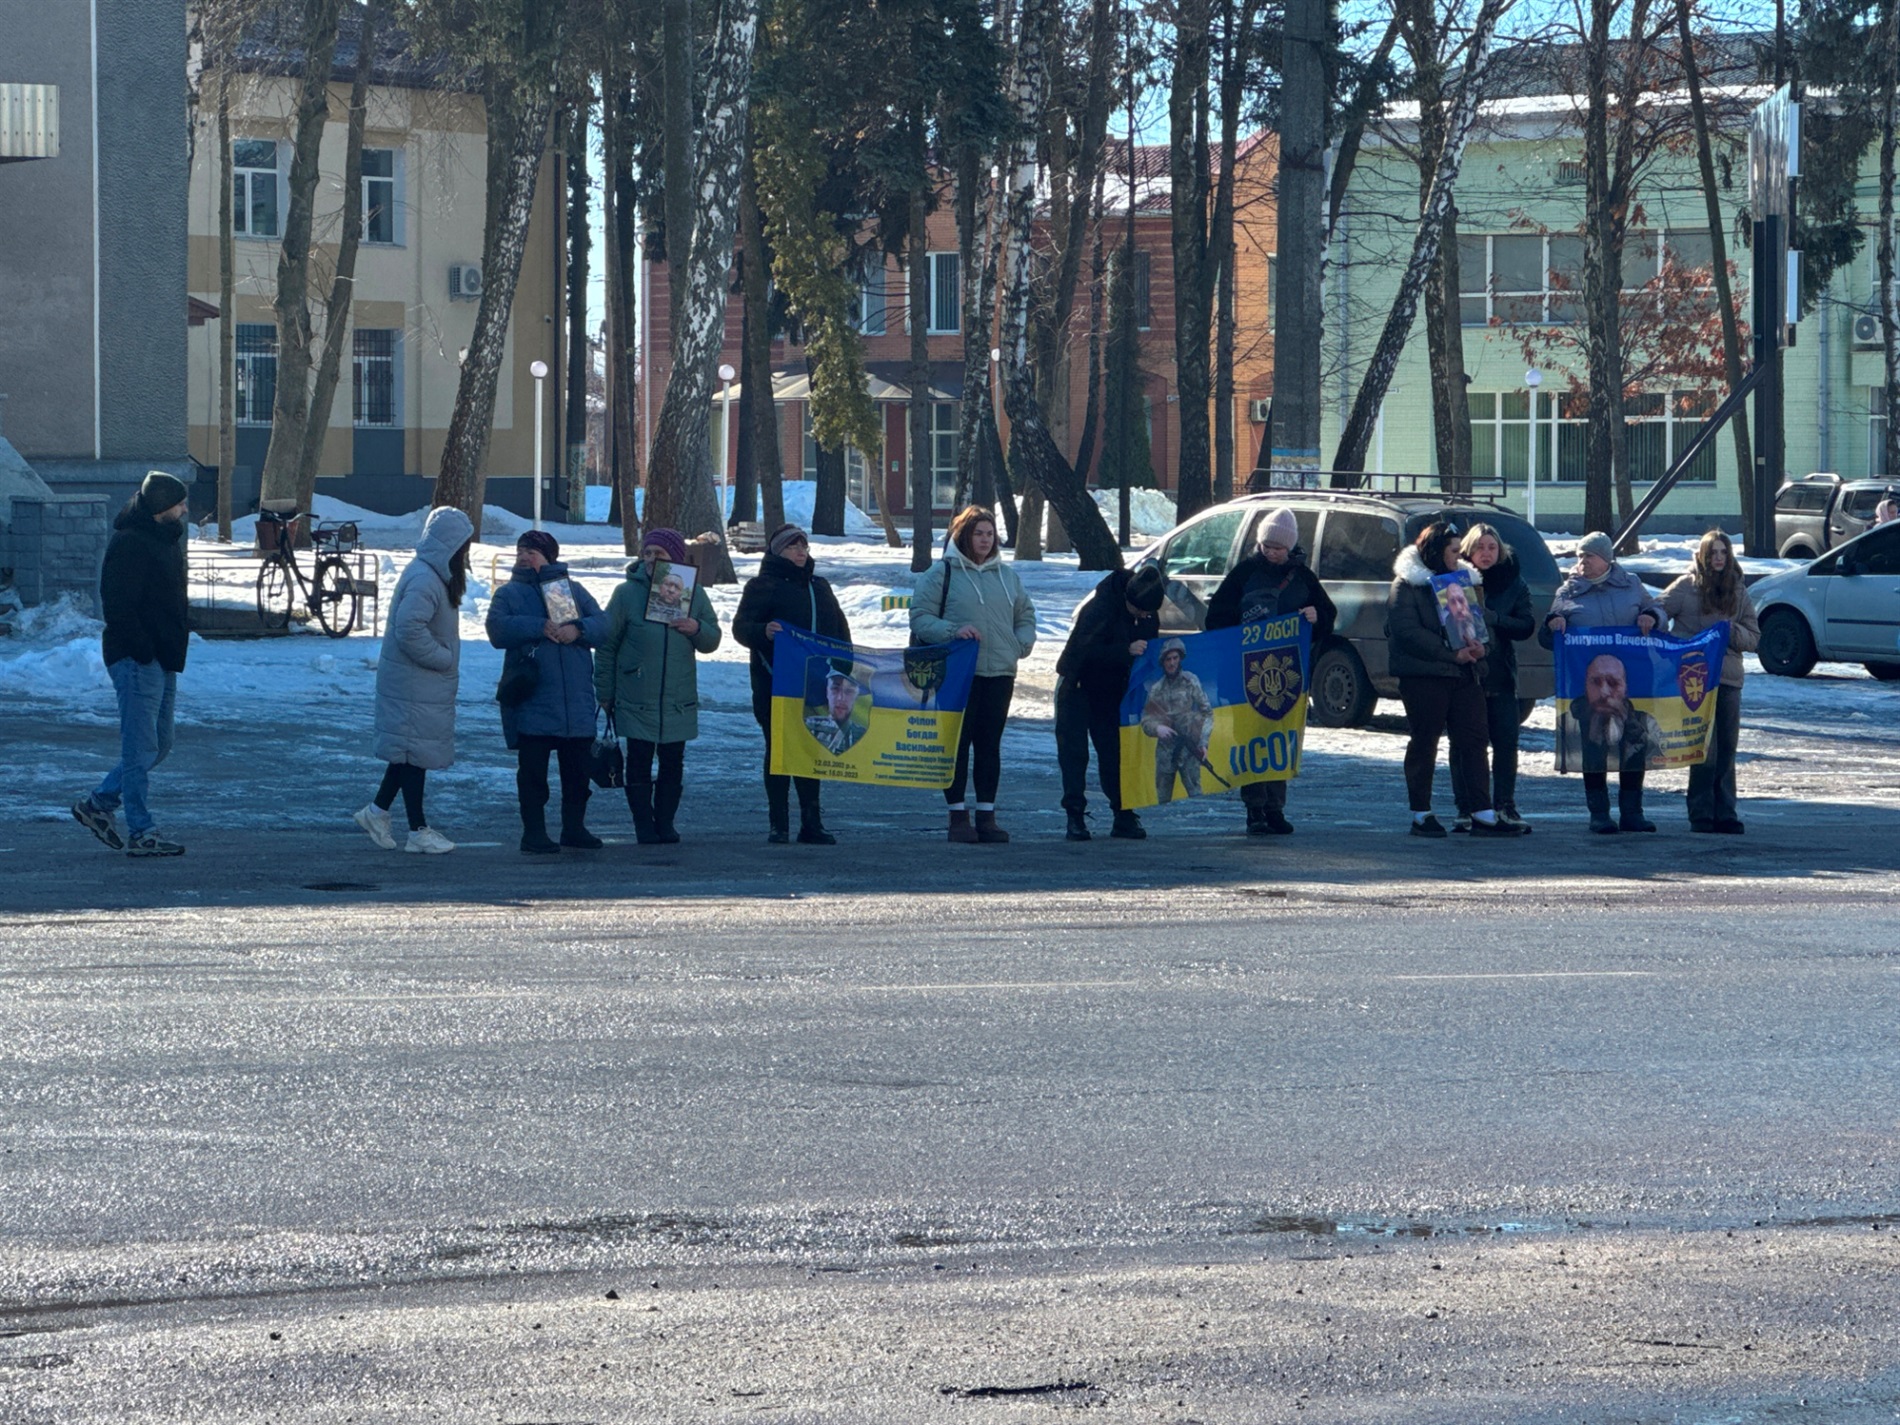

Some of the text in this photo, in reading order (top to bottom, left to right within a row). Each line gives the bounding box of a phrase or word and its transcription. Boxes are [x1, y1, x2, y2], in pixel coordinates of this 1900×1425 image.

[1242, 617, 1300, 646] 23 ОБСП
[907, 729, 938, 740] Богдан
